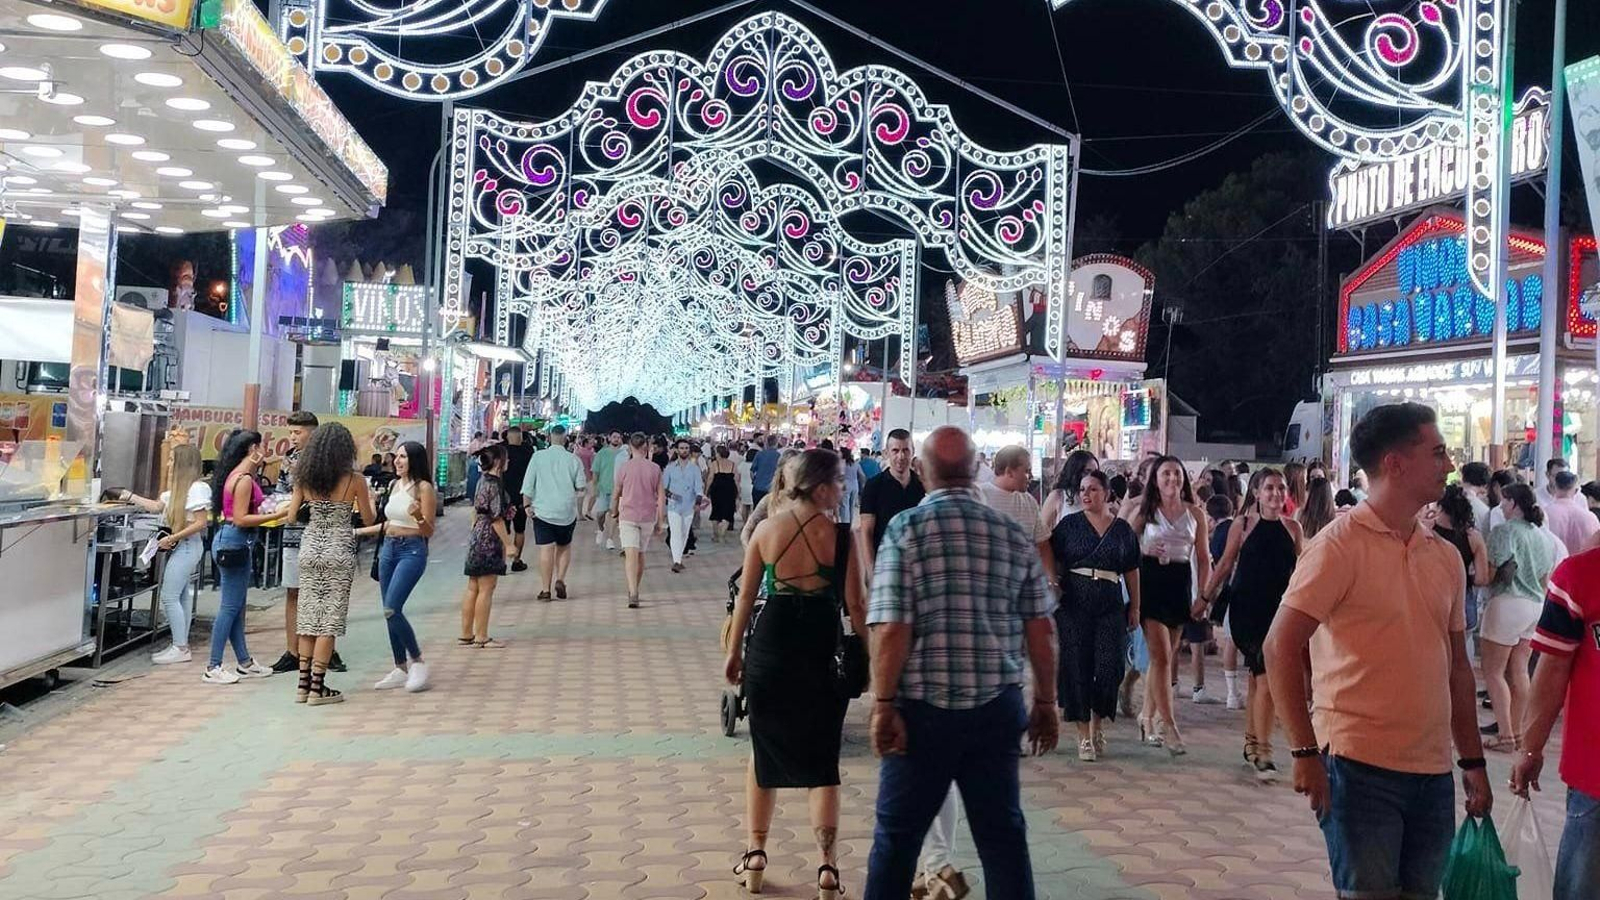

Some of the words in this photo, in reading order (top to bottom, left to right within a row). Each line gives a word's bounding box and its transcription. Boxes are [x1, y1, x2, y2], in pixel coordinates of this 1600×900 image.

[1335, 162, 1391, 224] PUNTO
[1393, 156, 1415, 209] DE
[1417, 110, 1544, 203] ENCURO
[353, 289, 425, 325] VINOS
